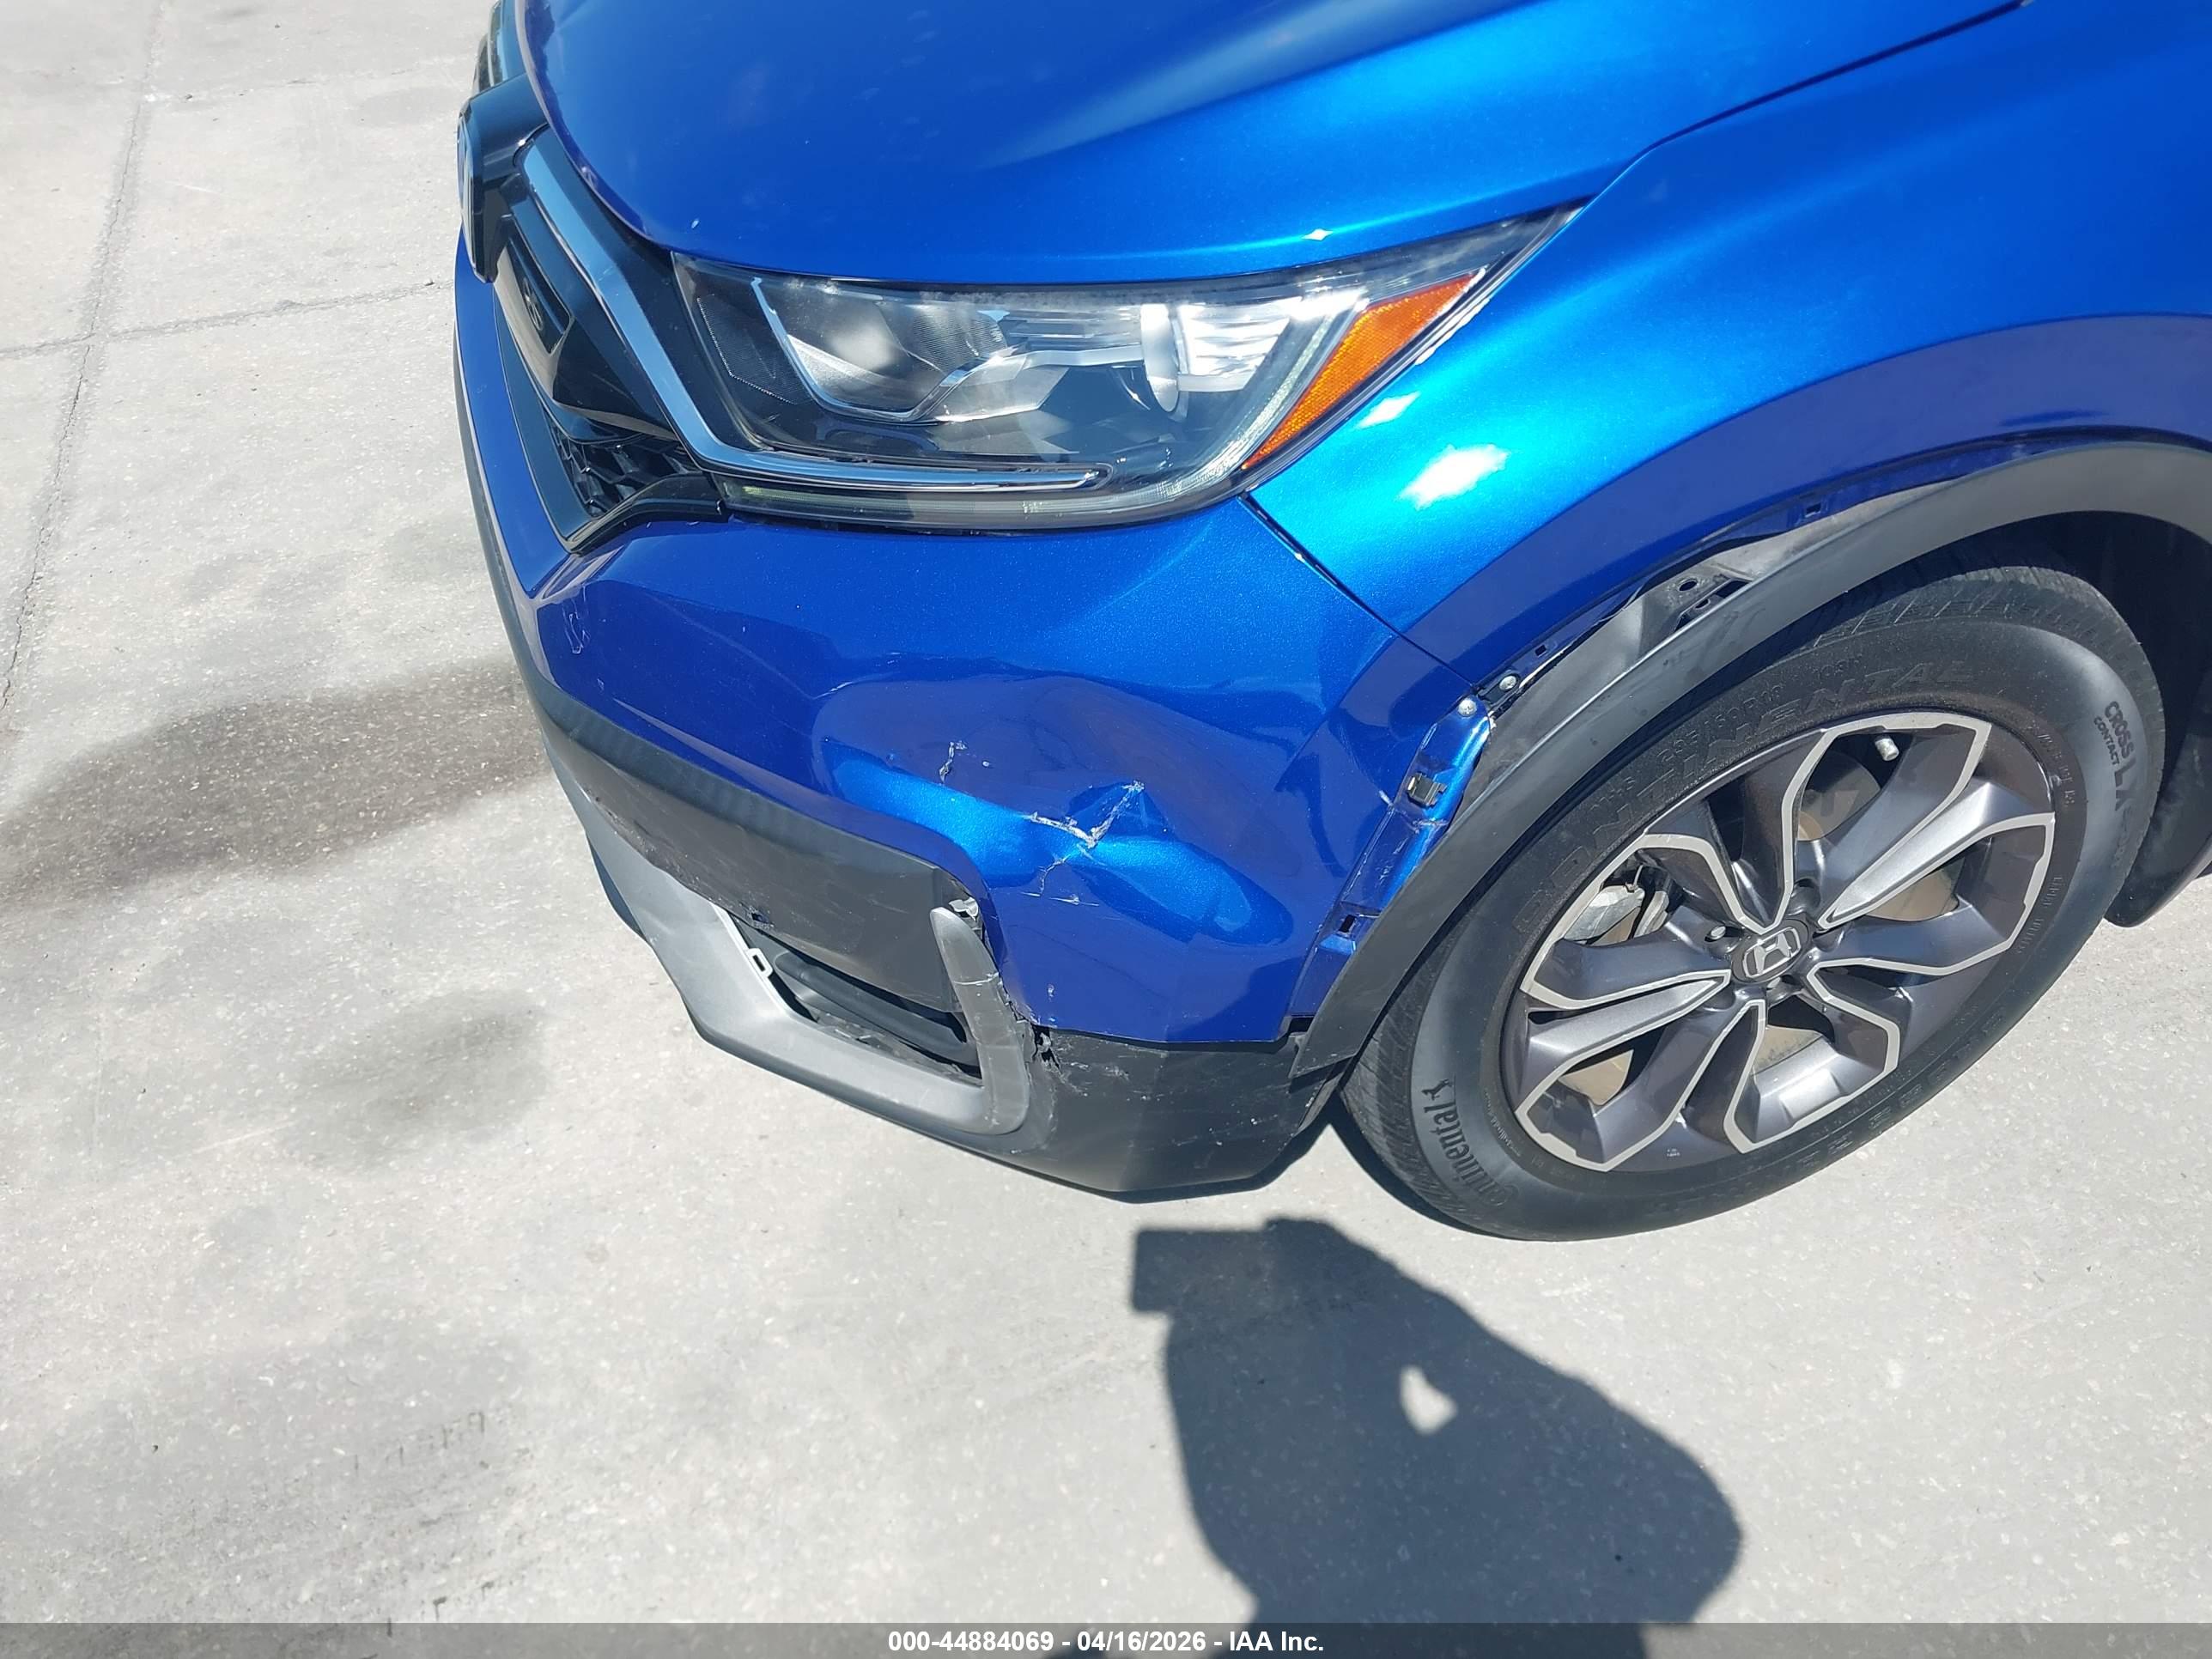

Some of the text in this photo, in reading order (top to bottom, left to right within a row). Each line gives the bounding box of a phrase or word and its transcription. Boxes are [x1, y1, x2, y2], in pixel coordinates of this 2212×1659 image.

[2093, 716, 2120, 766] CONTACT
[2104, 701, 2135, 759] CROSS
[2113, 757, 2138, 811] LX
[1423, 1102, 1520, 1206] Continental
